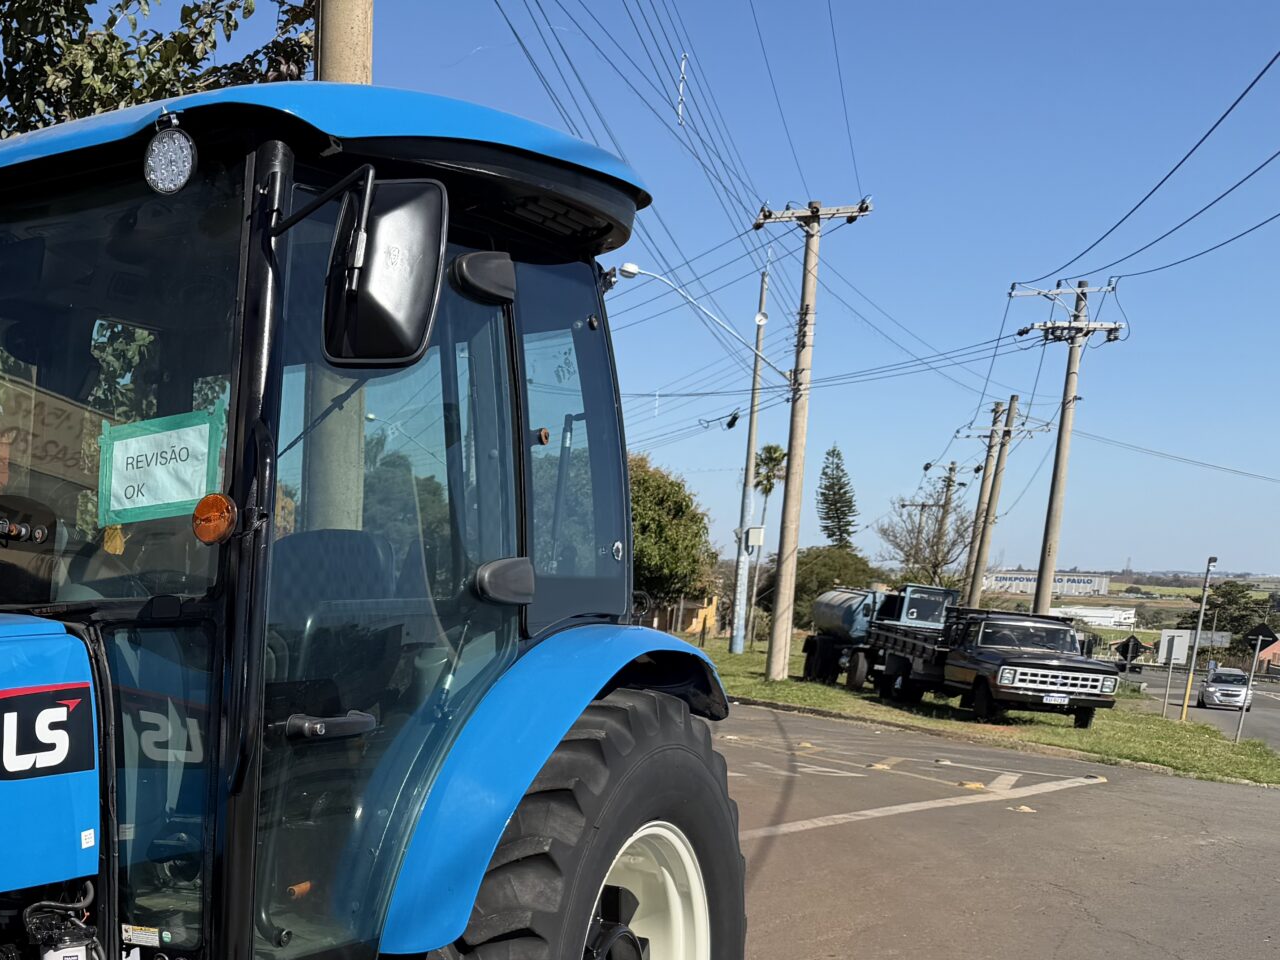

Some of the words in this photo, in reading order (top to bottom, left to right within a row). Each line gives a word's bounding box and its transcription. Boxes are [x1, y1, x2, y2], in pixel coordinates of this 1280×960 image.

[125, 445, 190, 472] REVISÃO
[124, 483, 145, 500] OK
[2, 704, 72, 772] LS
